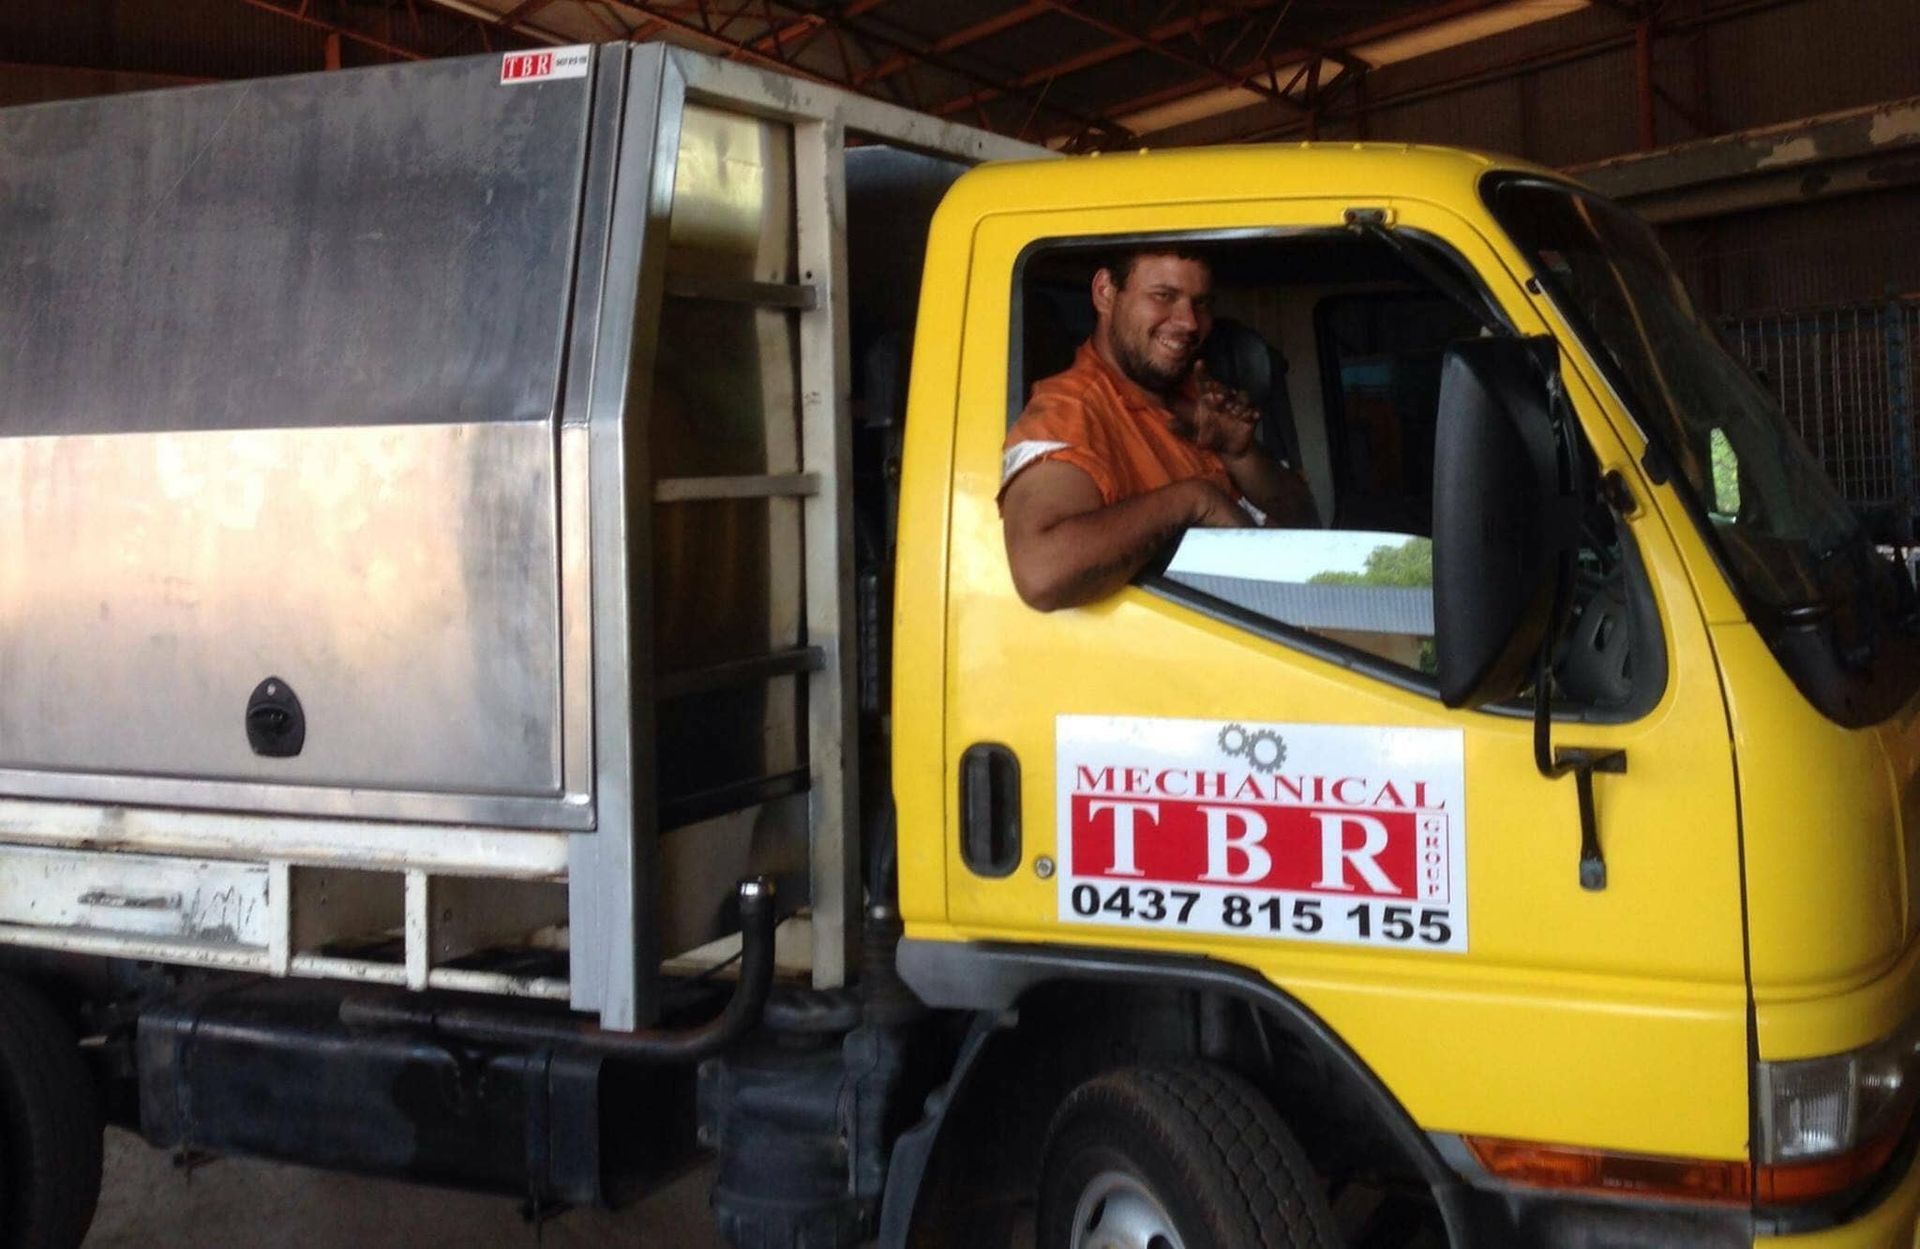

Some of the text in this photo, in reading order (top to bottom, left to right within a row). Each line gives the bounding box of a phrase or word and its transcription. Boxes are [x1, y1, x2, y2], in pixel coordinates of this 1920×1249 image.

[1076, 764, 1446, 810] MECHANICAL
[1088, 799, 1402, 895] TBR
[1423, 818, 1441, 897] GROUP
[1071, 883, 1452, 944] 0437 815 155
